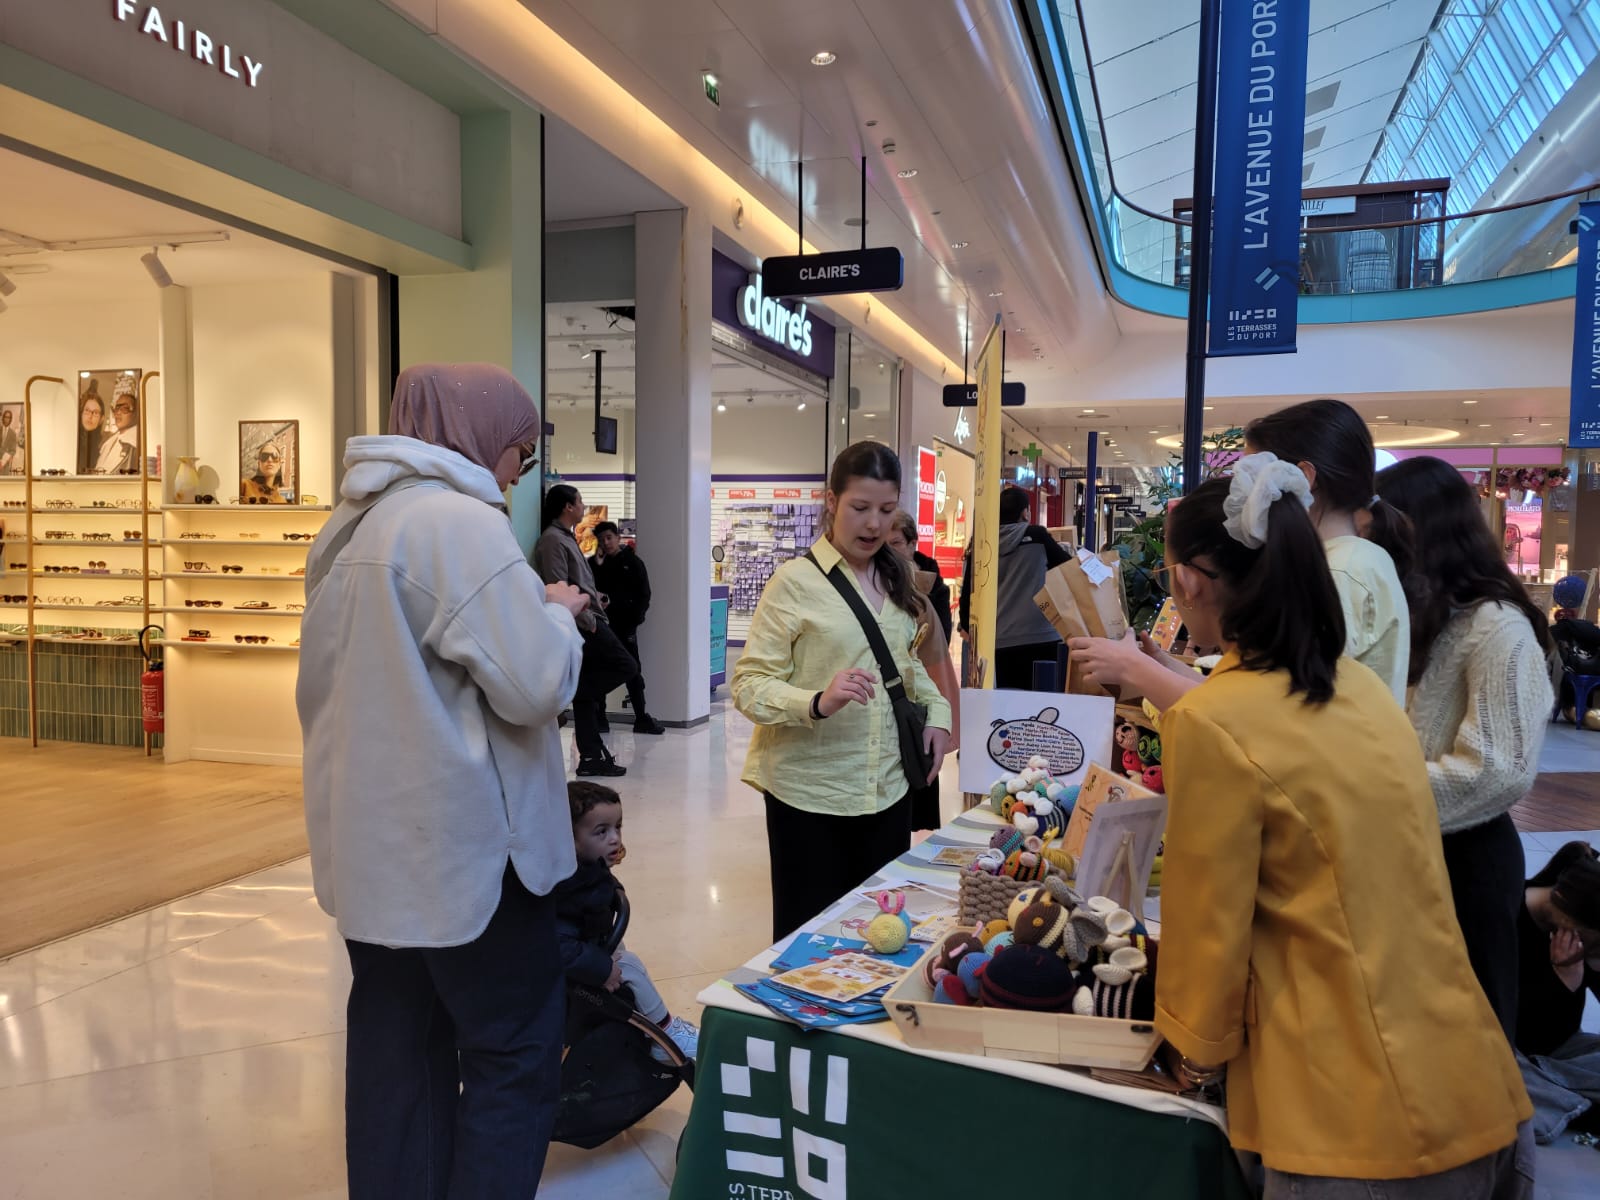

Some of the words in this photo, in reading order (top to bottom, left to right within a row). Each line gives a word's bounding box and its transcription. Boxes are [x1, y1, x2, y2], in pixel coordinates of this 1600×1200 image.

[1251, 0, 1278, 58] POR
[117, 0, 263, 87] FAIRLY
[1249, 65, 1276, 104] DU
[1243, 109, 1273, 249] L'AVENUE
[799, 263, 860, 281] CLAIRE'S
[742, 273, 813, 358] claire's
[1236, 323, 1277, 333] TERRASSES
[1227, 326, 1235, 341] LES
[1237, 332, 1249, 340] DU
[1252, 331, 1277, 340] PORT
[966, 391, 978, 400] LO
